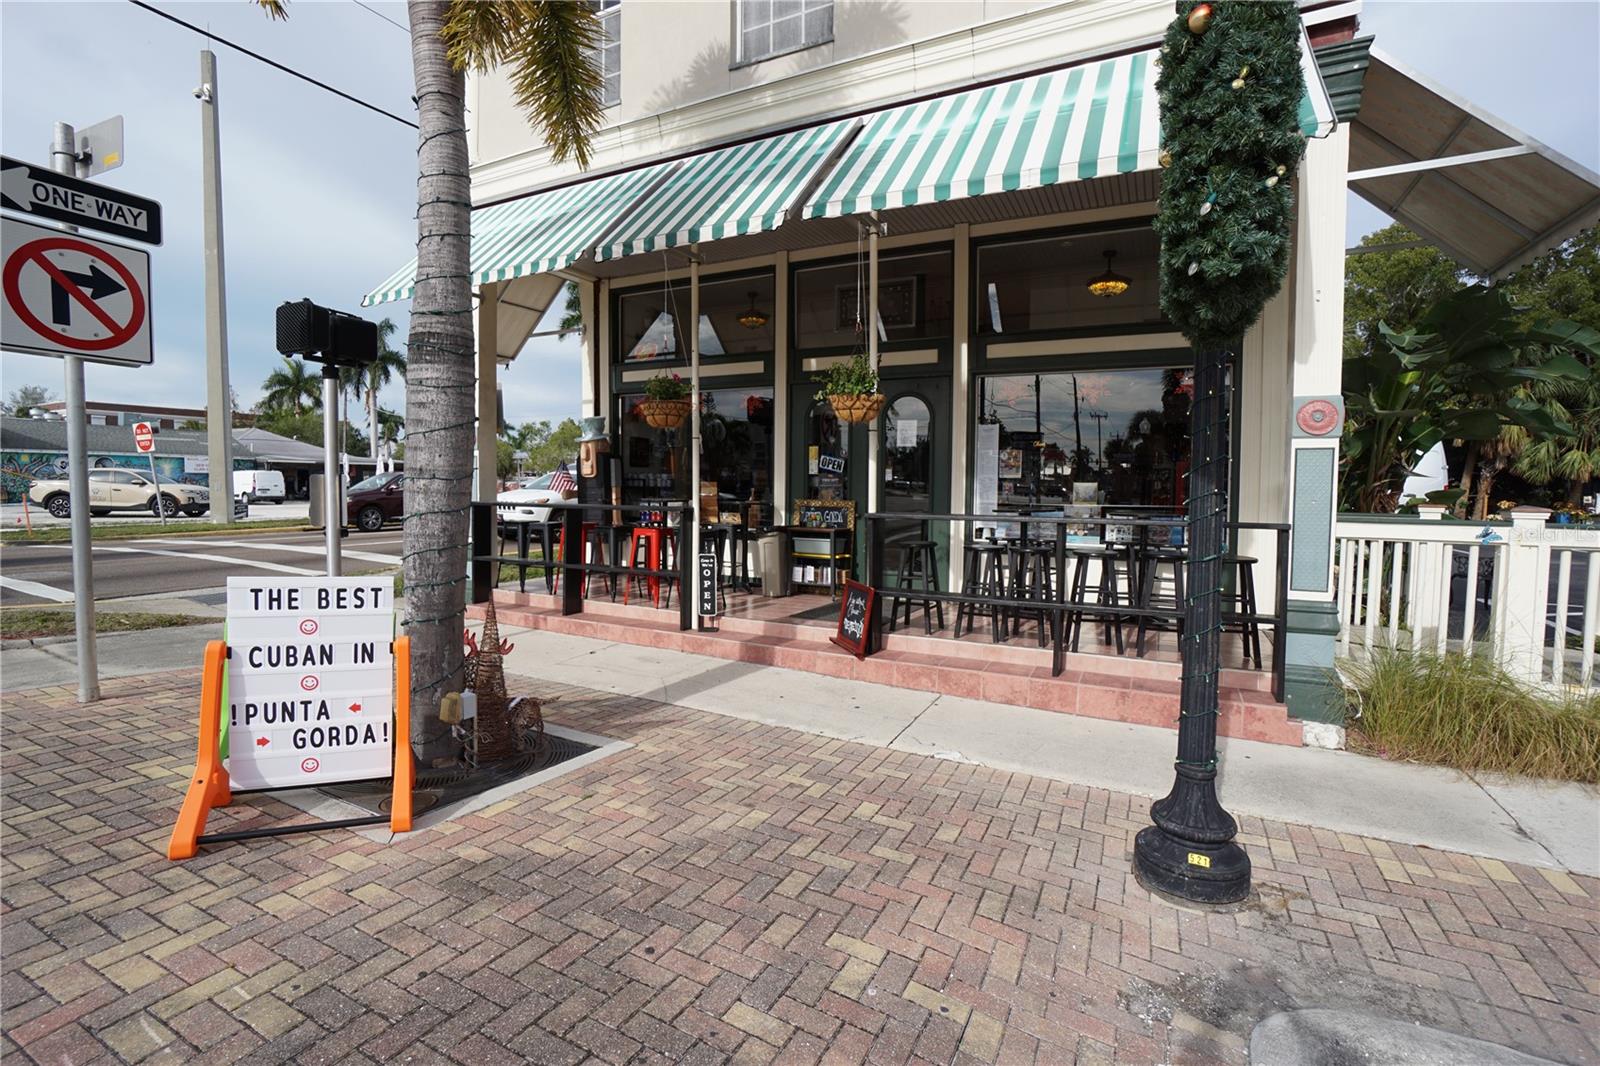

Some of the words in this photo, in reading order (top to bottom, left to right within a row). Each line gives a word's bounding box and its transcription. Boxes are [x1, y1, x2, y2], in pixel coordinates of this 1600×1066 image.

[32, 182, 86, 213] ONE
[95, 199, 143, 227] WAY
[821, 456, 843, 471] OPEN
[250, 588, 299, 610] THE
[317, 587, 383, 610] BEST
[703, 569, 711, 610] OPEN
[249, 644, 333, 668] CUBAN
[353, 642, 375, 664] IN
[292, 722, 389, 750] GORDA!
[1190, 854, 1208, 865] 521
